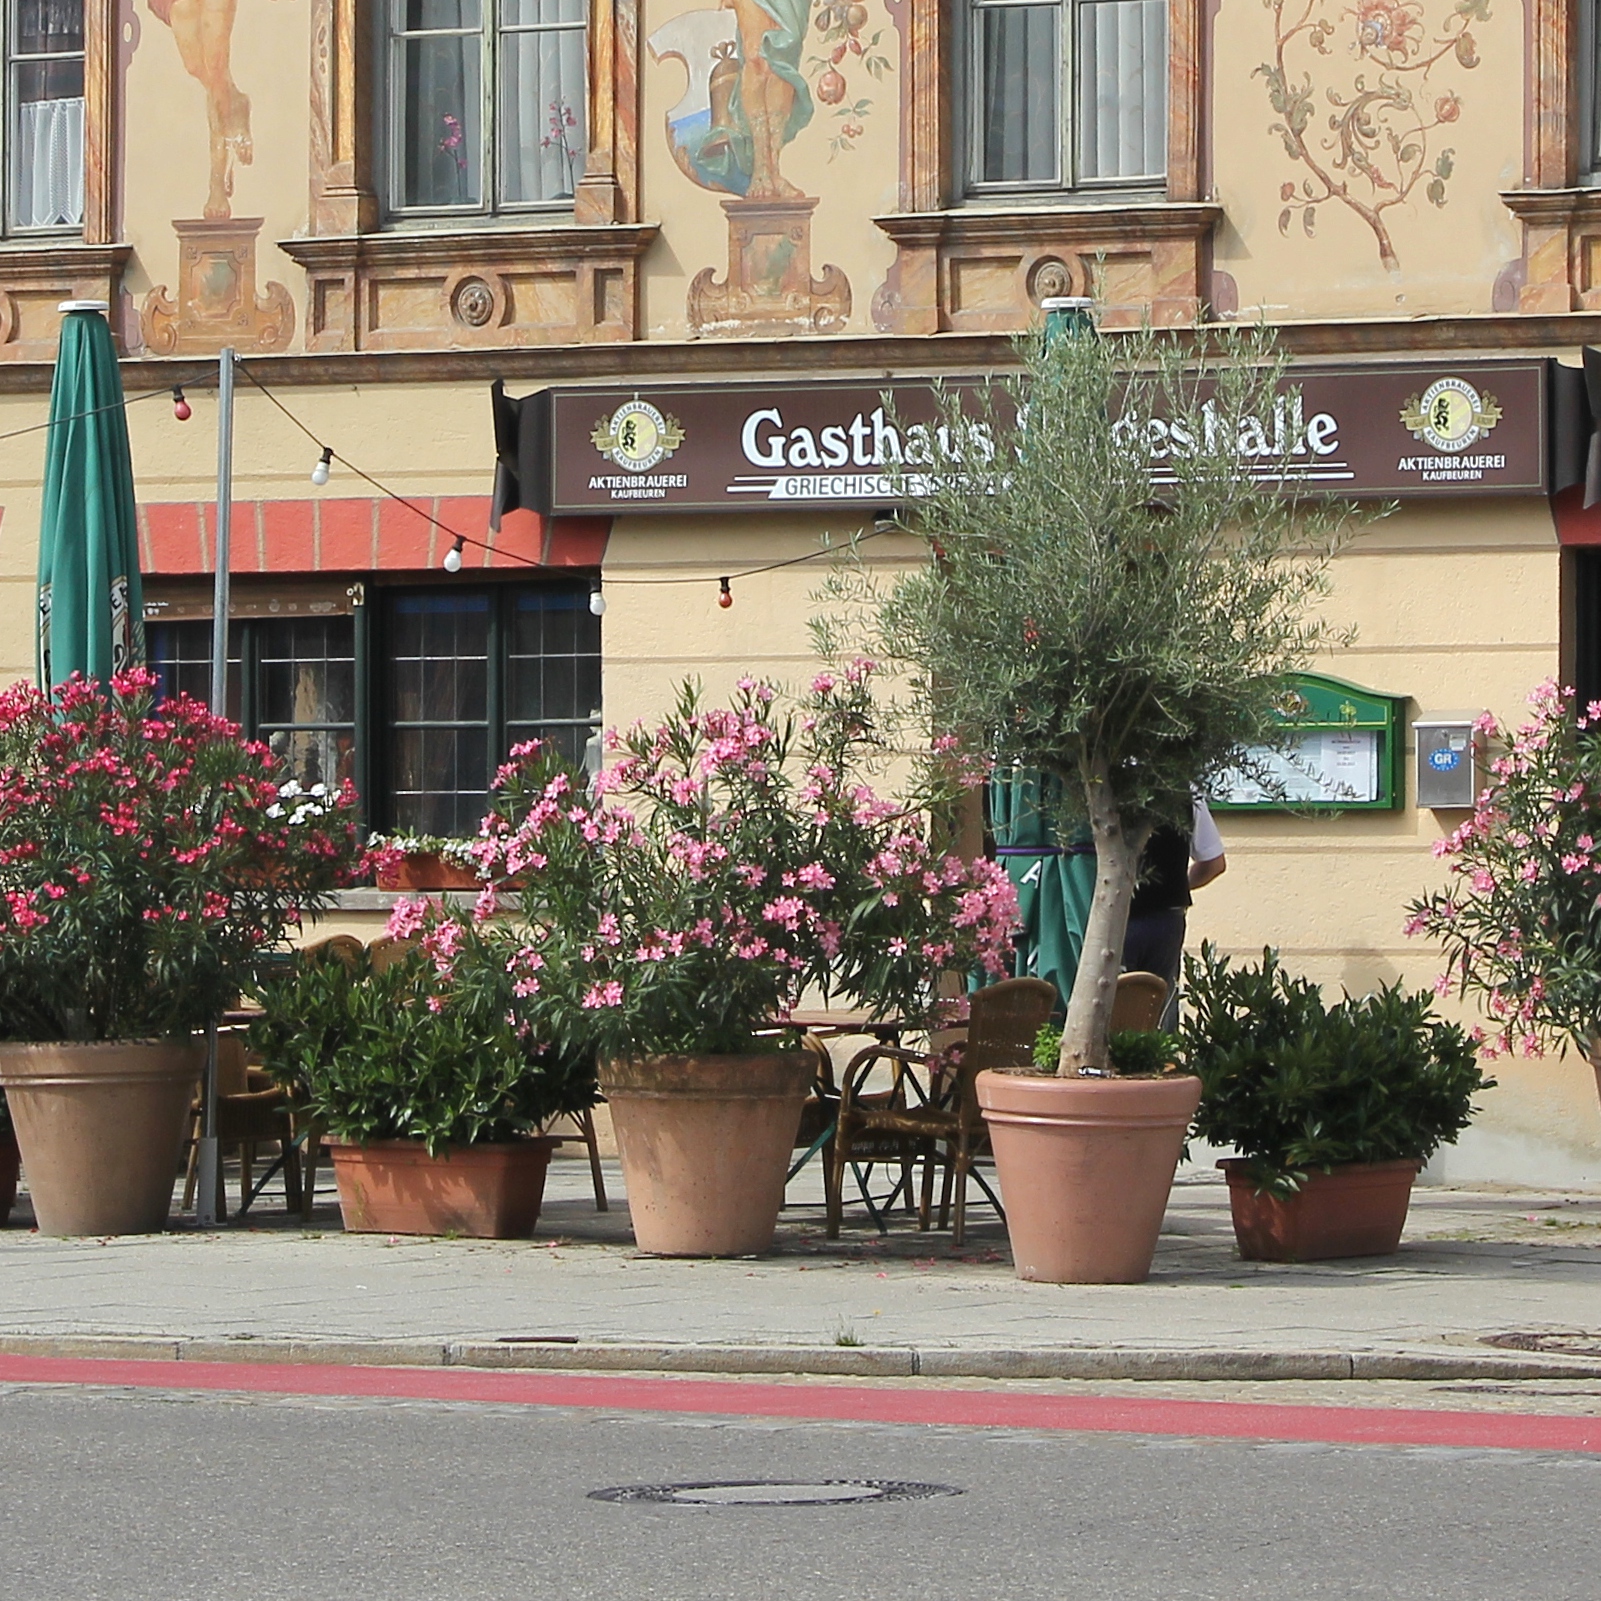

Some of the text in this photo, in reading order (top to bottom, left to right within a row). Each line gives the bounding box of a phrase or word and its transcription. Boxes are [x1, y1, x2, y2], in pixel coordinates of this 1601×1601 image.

[1421, 379, 1481, 411] AKTIENBRAUEREI
[610, 402, 665, 432] AKTIENBRAUEREI
[741, 406, 995, 469] Gasthaus
[1425, 428, 1478, 451] KAUFBEUREN
[614, 449, 662, 470] KAUFBEUREN
[1398, 454, 1506, 472] AKTIENBRAUEREI
[588, 474, 688, 490] AKTIENBRAUEREI
[1422, 470, 1483, 481] KAUFBEUREN
[610, 489, 666, 500] KAUFBEUREN
[1433, 752, 1453, 766] GR
